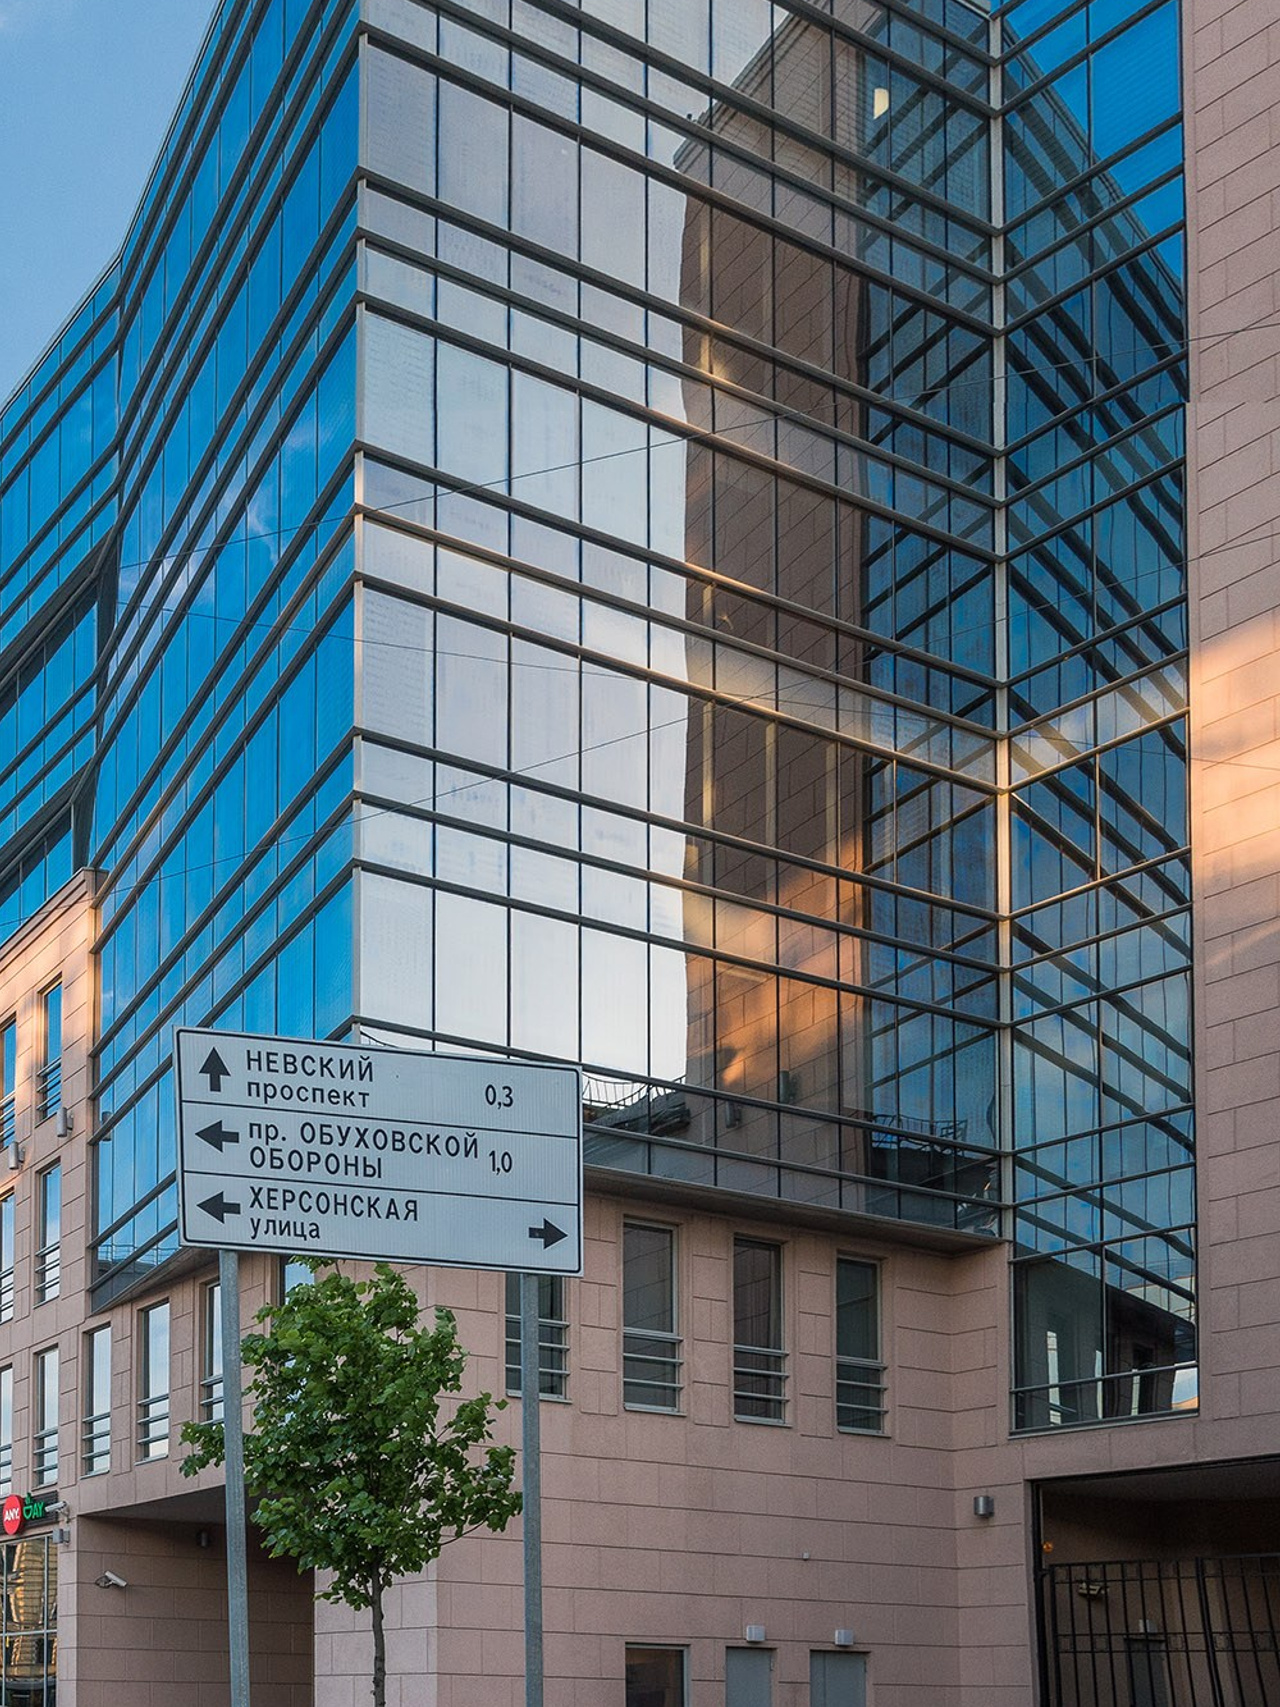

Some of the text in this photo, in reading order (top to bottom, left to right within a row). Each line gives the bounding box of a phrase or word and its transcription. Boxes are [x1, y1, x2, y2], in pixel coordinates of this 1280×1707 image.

[246, 1049, 373, 1083] НЕВСКИЙ
[247, 1081, 370, 1108] проспект
[484, 1084, 514, 1110] 0,3
[249, 1121, 478, 1159] пр. ОБУХОВСКОЙ
[249, 1145, 382, 1179] ОБОРОНЫ
[488, 1150, 513, 1176] 1,0
[249, 1185, 418, 1222] ХЕРСОНСКАЯ
[249, 1217, 321, 1242] улица
